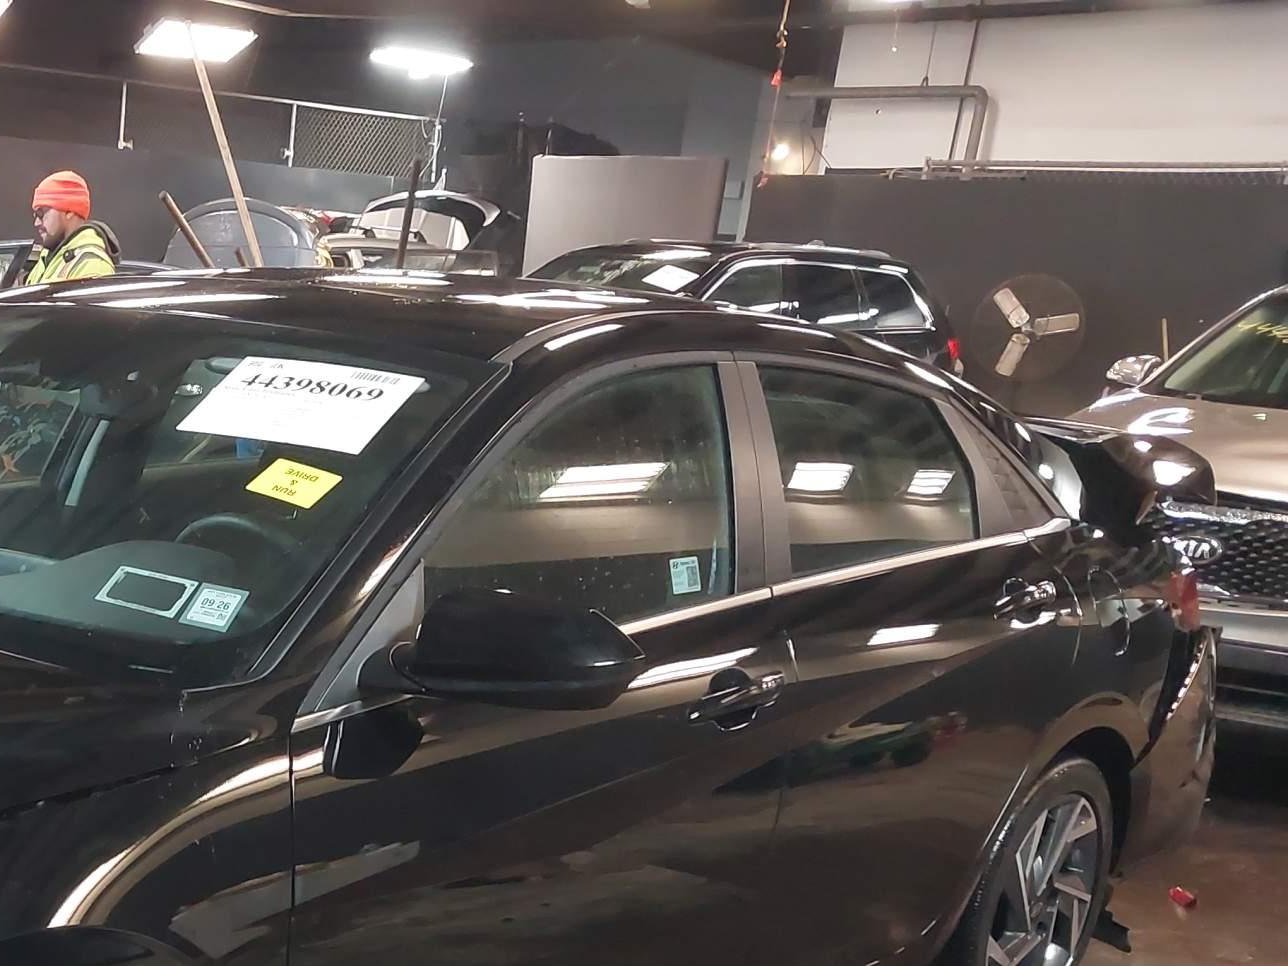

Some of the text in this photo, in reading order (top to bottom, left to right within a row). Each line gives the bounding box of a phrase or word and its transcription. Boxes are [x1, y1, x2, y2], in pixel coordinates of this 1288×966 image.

[241, 373, 384, 401] 44398069
[284, 468, 319, 482] DRIVE
[272, 485, 297, 496] RUN
[217, 600, 232, 611] 26
